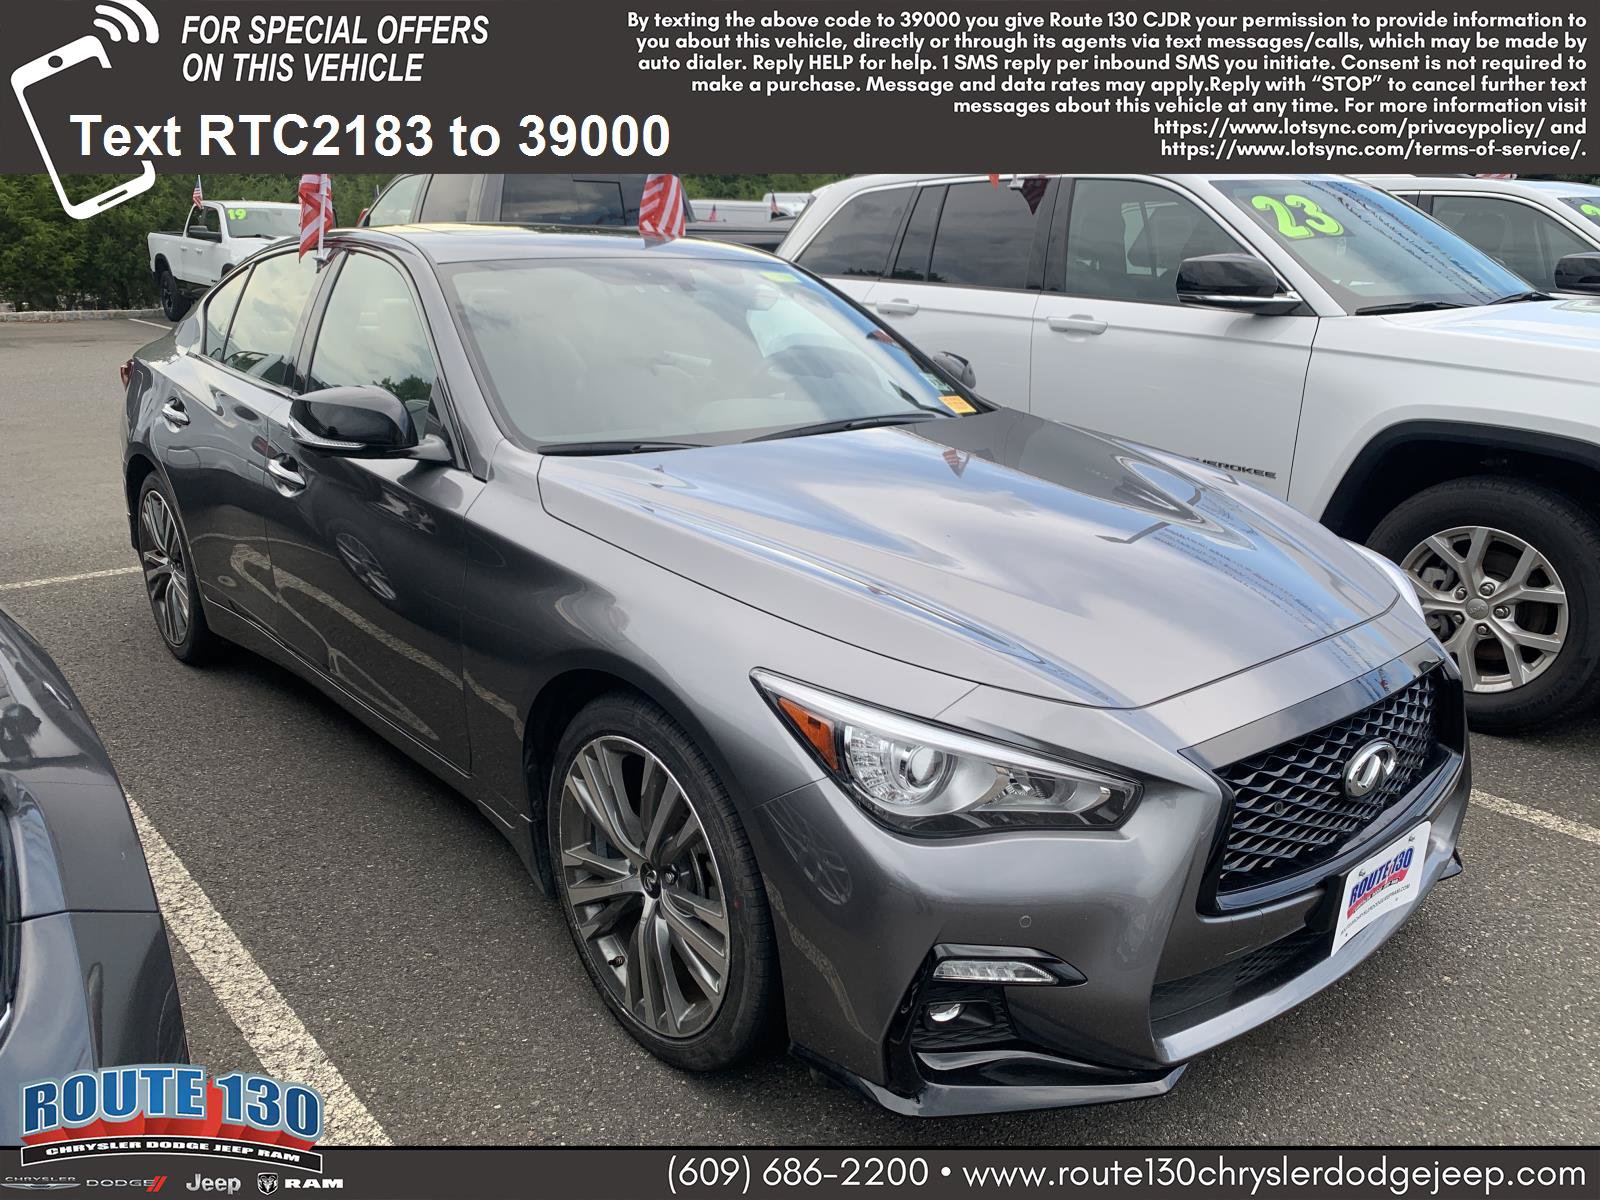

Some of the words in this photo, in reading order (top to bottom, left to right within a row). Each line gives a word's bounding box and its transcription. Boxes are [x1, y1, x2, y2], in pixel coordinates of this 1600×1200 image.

[227, 207, 247, 221] 19
[1251, 194, 1344, 239] 23
[1348, 860, 1392, 909] ROUTE
[1391, 847, 1414, 875] 130
